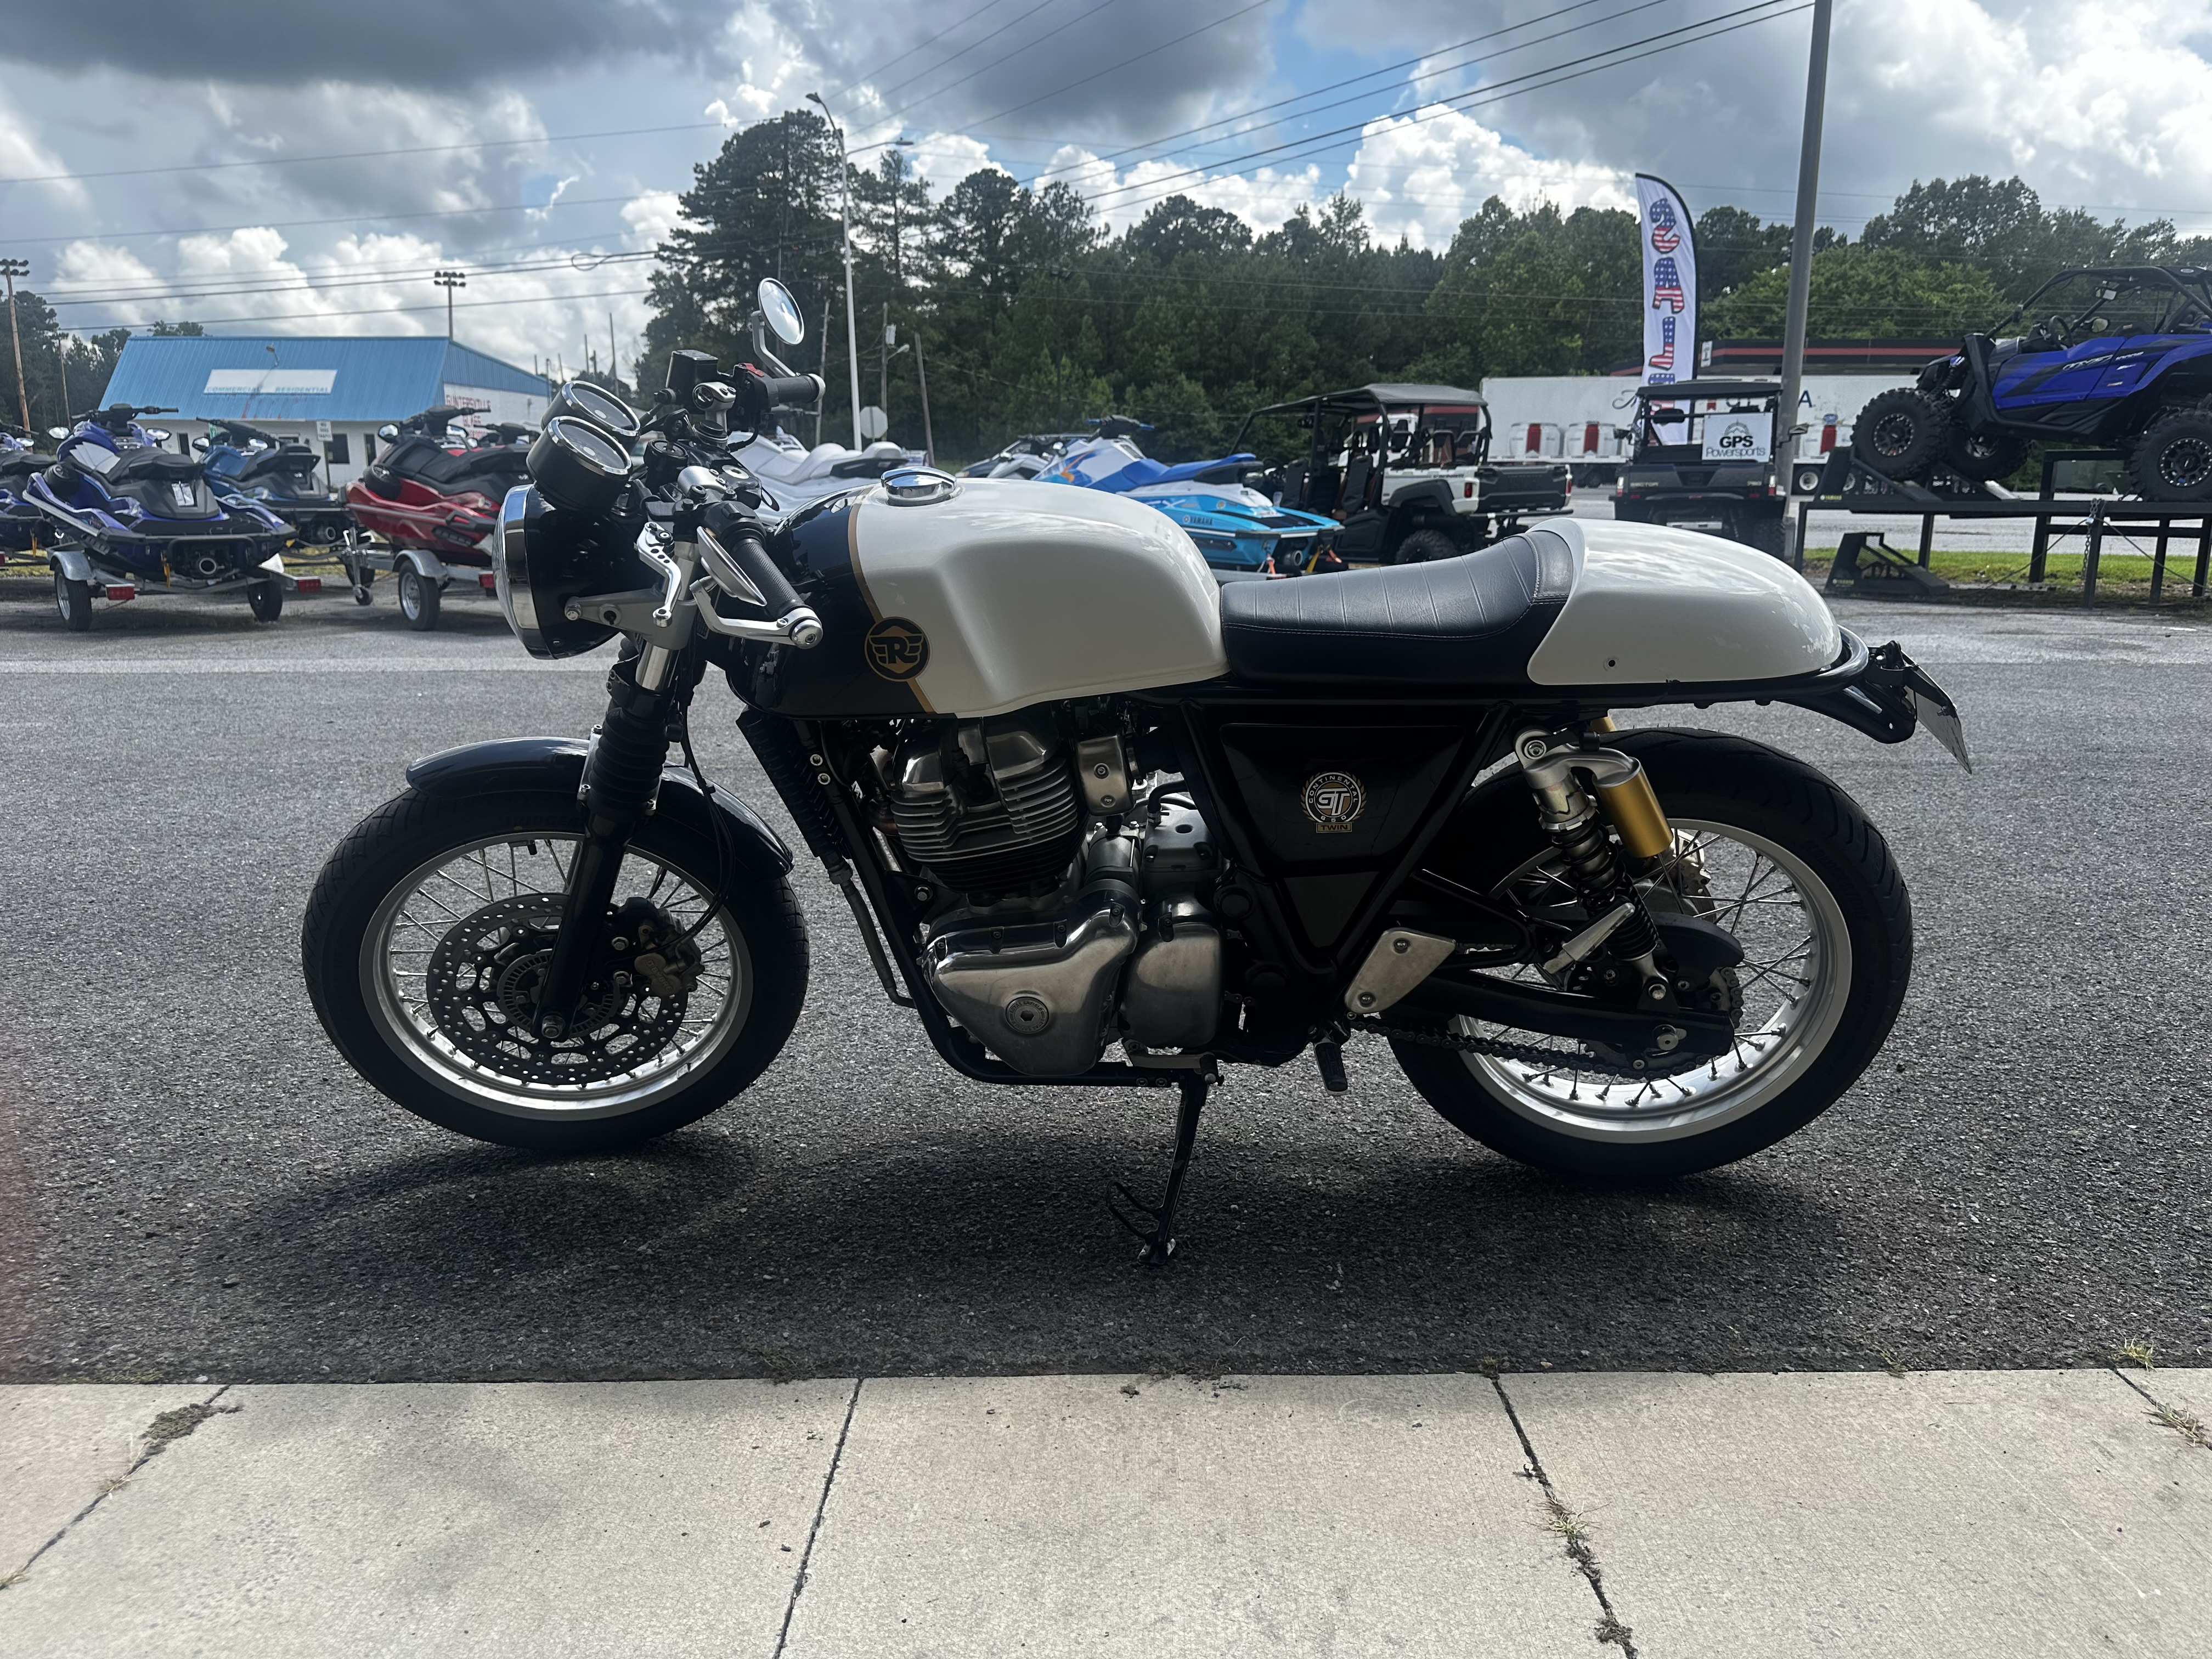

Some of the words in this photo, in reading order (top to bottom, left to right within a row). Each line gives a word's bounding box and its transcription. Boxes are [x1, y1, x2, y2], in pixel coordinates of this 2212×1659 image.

[1719, 435, 1754, 448] GPS
[1706, 446, 1766, 459] Powersports
[1190, 516, 1214, 526] YAMAHA
[1308, 775, 1358, 804] CONTINENTAL
[1316, 788, 1351, 816] GT
